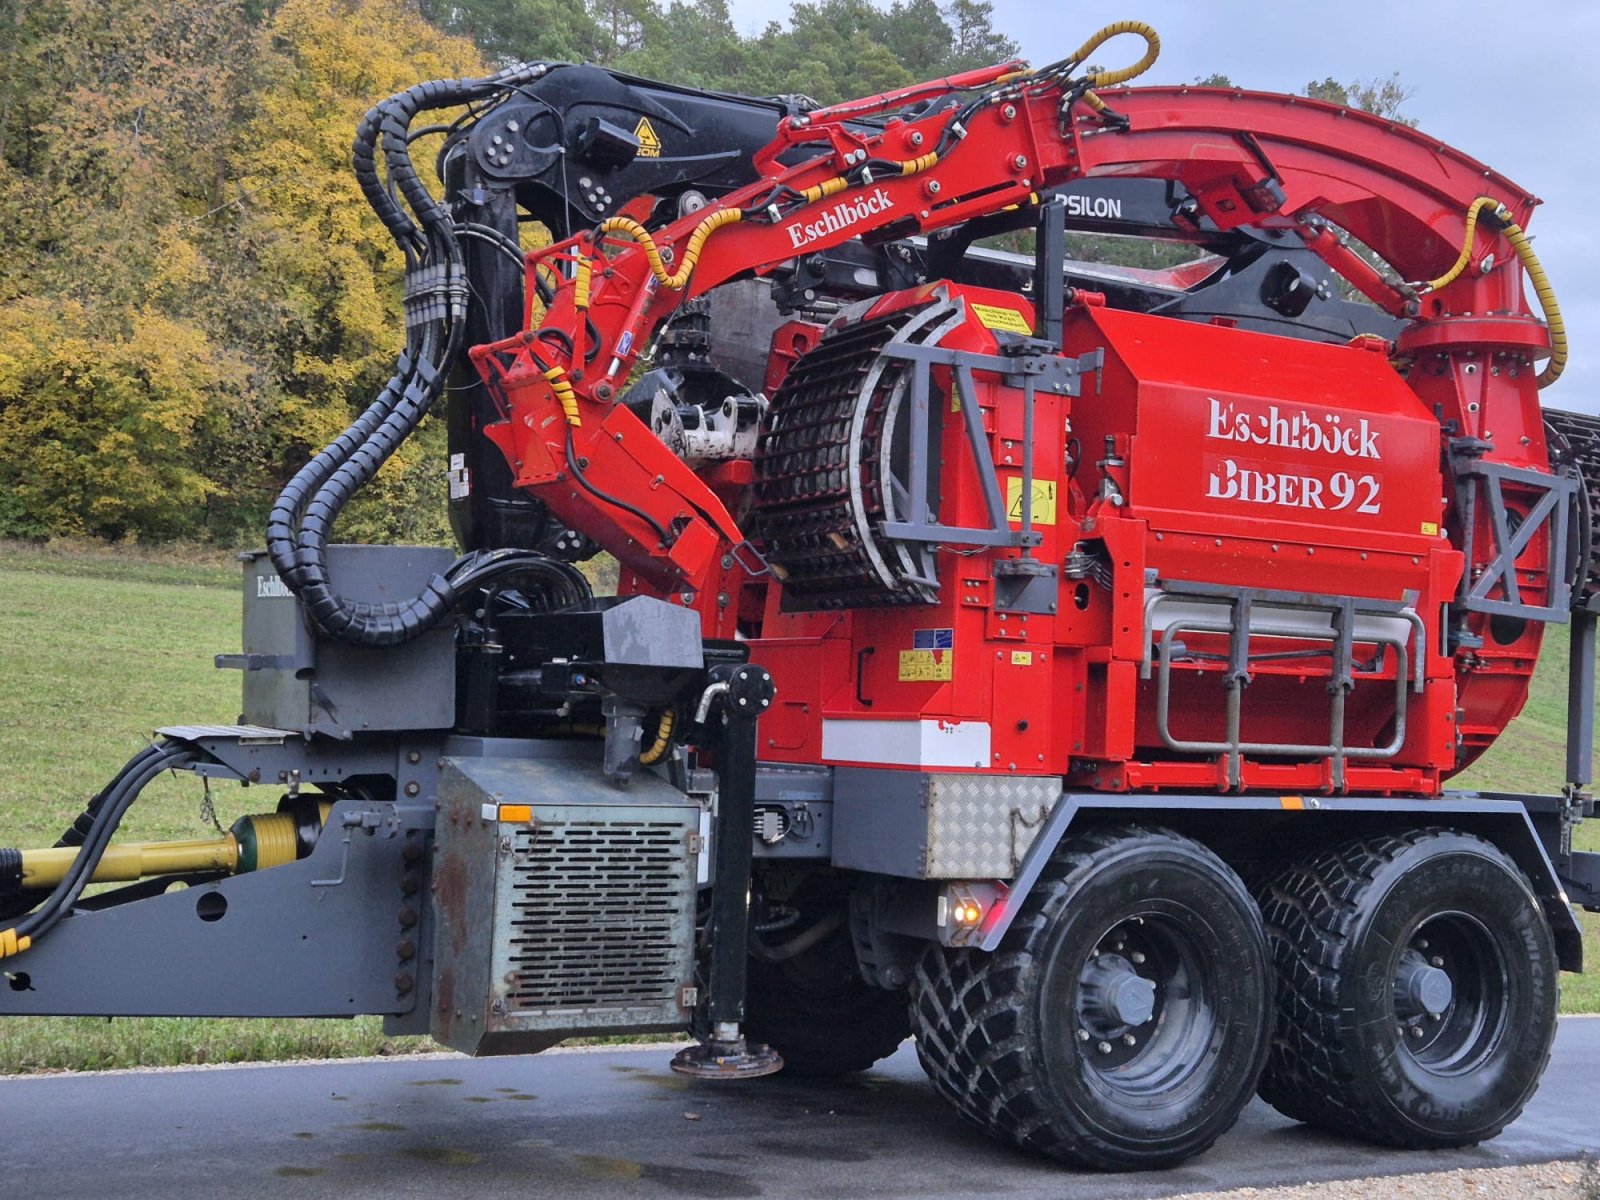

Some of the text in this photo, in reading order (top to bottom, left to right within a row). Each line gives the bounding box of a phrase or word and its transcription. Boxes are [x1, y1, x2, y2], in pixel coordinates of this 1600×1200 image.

[785, 188, 894, 249] Eschlböck
[1206, 397, 1381, 460] Eschlböck
[1205, 459, 1382, 515] BIBER 92
